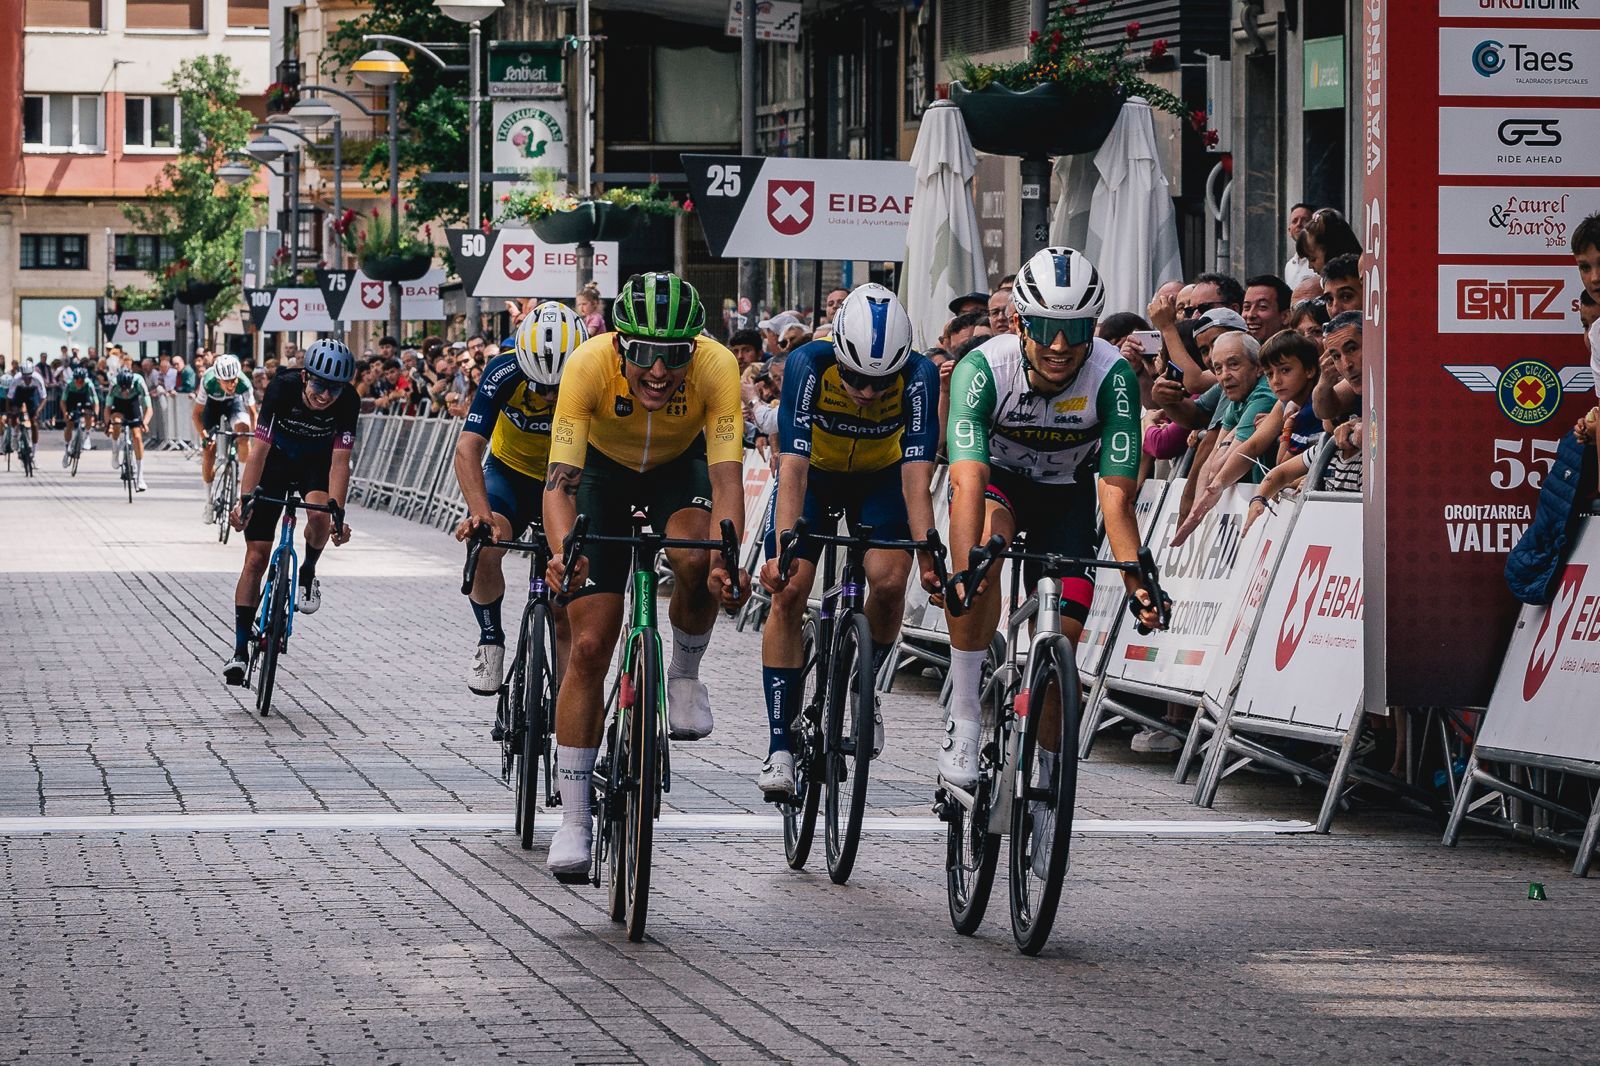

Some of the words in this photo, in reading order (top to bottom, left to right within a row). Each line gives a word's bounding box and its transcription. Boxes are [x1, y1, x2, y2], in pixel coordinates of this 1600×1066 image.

[1508, 44, 1574, 72] Taes
[1553, 78, 1589, 86] ESPECIALES
[1497, 156, 1521, 164] RIDE
[1525, 156, 1562, 164] AHEAD
[706, 164, 742, 198] 25
[828, 217, 855, 226] Udala
[1488, 204, 1510, 229] &
[1503, 193, 1570, 213] Laurel
[1507, 215, 1567, 240] Hardy
[461, 233, 487, 257] 50
[1545, 236, 1567, 248] Pub
[544, 252, 609, 266] EIBR
[328, 274, 348, 291] 75
[400, 286, 438, 296] IBAR
[250, 292, 272, 307] 100
[104, 313, 119, 325] 150
[1503, 368, 1522, 388] CLUB
[1525, 365, 1556, 389] CICLISTA
[801, 374, 817, 411] CORTIZO
[912, 395, 922, 432] CORTIZO
[1511, 406, 1548, 420] EIBARRES
[555, 417, 575, 445] ESP
[715, 415, 735, 441] ESP
[1490, 438, 1561, 490] 55
[1444, 504, 1532, 521] OROITZARREA
[1168, 600, 1222, 637] COUNTRY
[773, 690, 781, 720] CORTIZO
